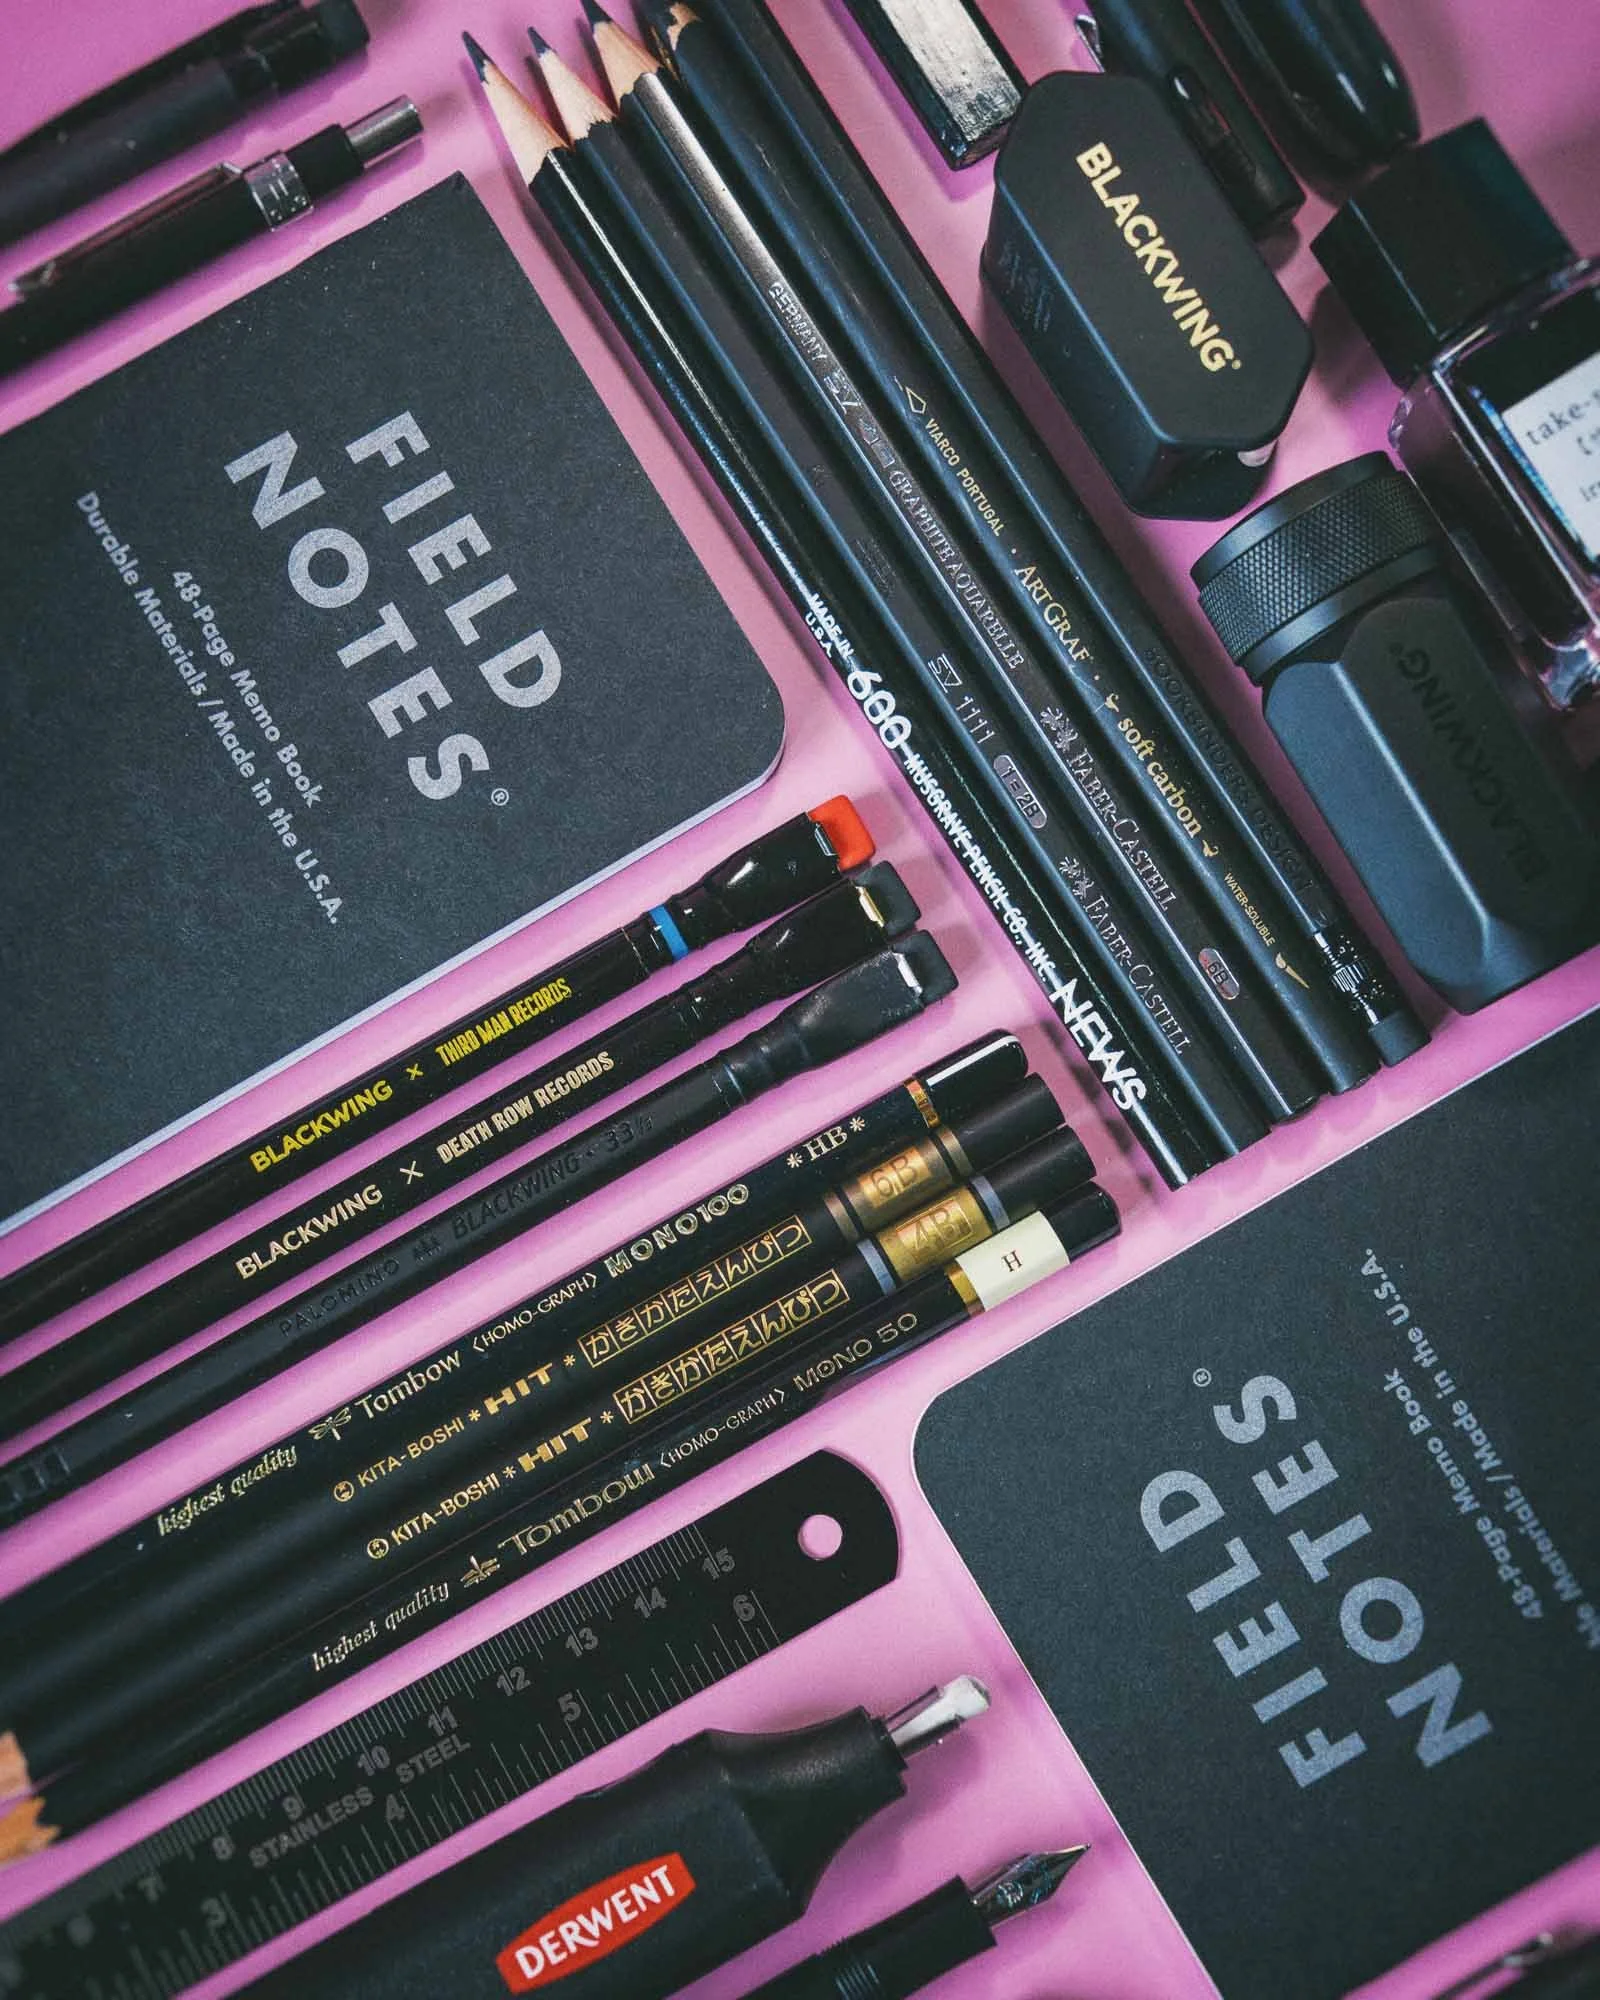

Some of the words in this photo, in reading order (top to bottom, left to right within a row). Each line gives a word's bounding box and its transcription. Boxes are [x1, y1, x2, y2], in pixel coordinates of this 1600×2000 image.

[345, 410, 561, 707] FIELD
[765, 279, 827, 365] GERMANY
[885, 465, 957, 565] GRAPHITE
[942, 555, 1027, 673] AQUARELLE
[1205, 959, 1230, 986] 6B
[807, 591, 843, 638] MADE
[832, 632, 856, 659] IN
[77, 491, 138, 584] Durable
[134, 587, 207, 695] Materials
[208, 710, 255, 777] Made
[251, 777, 271, 806] in
[267, 807, 297, 847] the
[295, 848, 342, 924] U.S.A.
[172, 571, 234, 666] 48-Page
[229, 669, 280, 741] Memo
[276, 743, 322, 808] Book
[841, 659, 918, 753] 600
[924, 417, 959, 466] VIARCO
[956, 467, 1003, 540] PORTUGAL
[1114, 717, 1155, 763] soft
[1142, 761, 1201, 842] carbon
[1223, 872, 1275, 946] WATER-SOLUBLE
[951, 692, 996, 746] 1111
[901, 751, 973, 849] MUSGRAVE
[960, 843, 1015, 913] PENCIL
[997, 904, 1036, 947] CO.,
[1022, 940, 1060, 984] INC.
[250, 1080, 392, 1172] BLACKWING
[435, 1029, 480, 1065] THIRD
[475, 1010, 513, 1044] MAN
[507, 977, 571, 1025] RECORDS
[1045, 975, 1153, 1115] NEWS
[235, 1184, 382, 1278] BLACKWING
[436, 1119, 493, 1163] DEATH
[490, 1095, 533, 1131] ROW
[533, 1051, 614, 1108] RECORDS
[275, 1254, 405, 1340] PALOMINO
[446, 1149, 585, 1242] BLACKWING
[357, 1416, 464, 1487] KITA-BOSHI
[483, 1362, 552, 1414] HIT
[581, 1217, 808, 1362] かきかたえんぴつ
[867, 1152, 921, 1201] 6B
[1001, 1250, 1022, 1272] H
[1351, 1244, 1414, 1327] U.S.A.
[1398, 1322, 1442, 1372] the
[157, 1482, 225, 1536] highest
[230, 1445, 296, 1496] quality
[354, 1350, 460, 1418] Tombow
[391, 1472, 500, 1545] KITA-BOSHI
[517, 1417, 591, 1472] HIT
[617, 1271, 846, 1419] かきかたえんぴつ
[1377, 1364, 1434, 1437] Book
[1419, 1431, 1482, 1517] Memo
[1426, 1366, 1459, 1400] in
[1444, 1394, 1505, 1473] Made
[311, 1620, 377, 1671] highest
[384, 1582, 448, 1630] quality
[495, 1458, 657, 1565] Tombow
[792, 1338, 872, 1391] MONO
[876, 1312, 917, 1342] 50
[1468, 1509, 1552, 1625] 48-Page
[1496, 1479, 1585, 1606] Materials
[278, 1792, 306, 1822] 9
[352, 1741, 394, 1780] 10
[423, 1704, 460, 1740] 11
[493, 1663, 533, 1700] 12
[561, 1623, 602, 1660] 13
[630, 1584, 670, 1621] 14
[698, 1543, 740, 1583] 15
[376, 1789, 411, 1827] 4
[553, 1690, 585, 1724] 5
[728, 1591, 759, 1625] 6
[1139, 1470, 1365, 1787] FIELD
[245, 1782, 378, 1872] STAINLESS
[392, 1728, 472, 1786] STEEL
[514, 1864, 682, 1979] DERWENT
